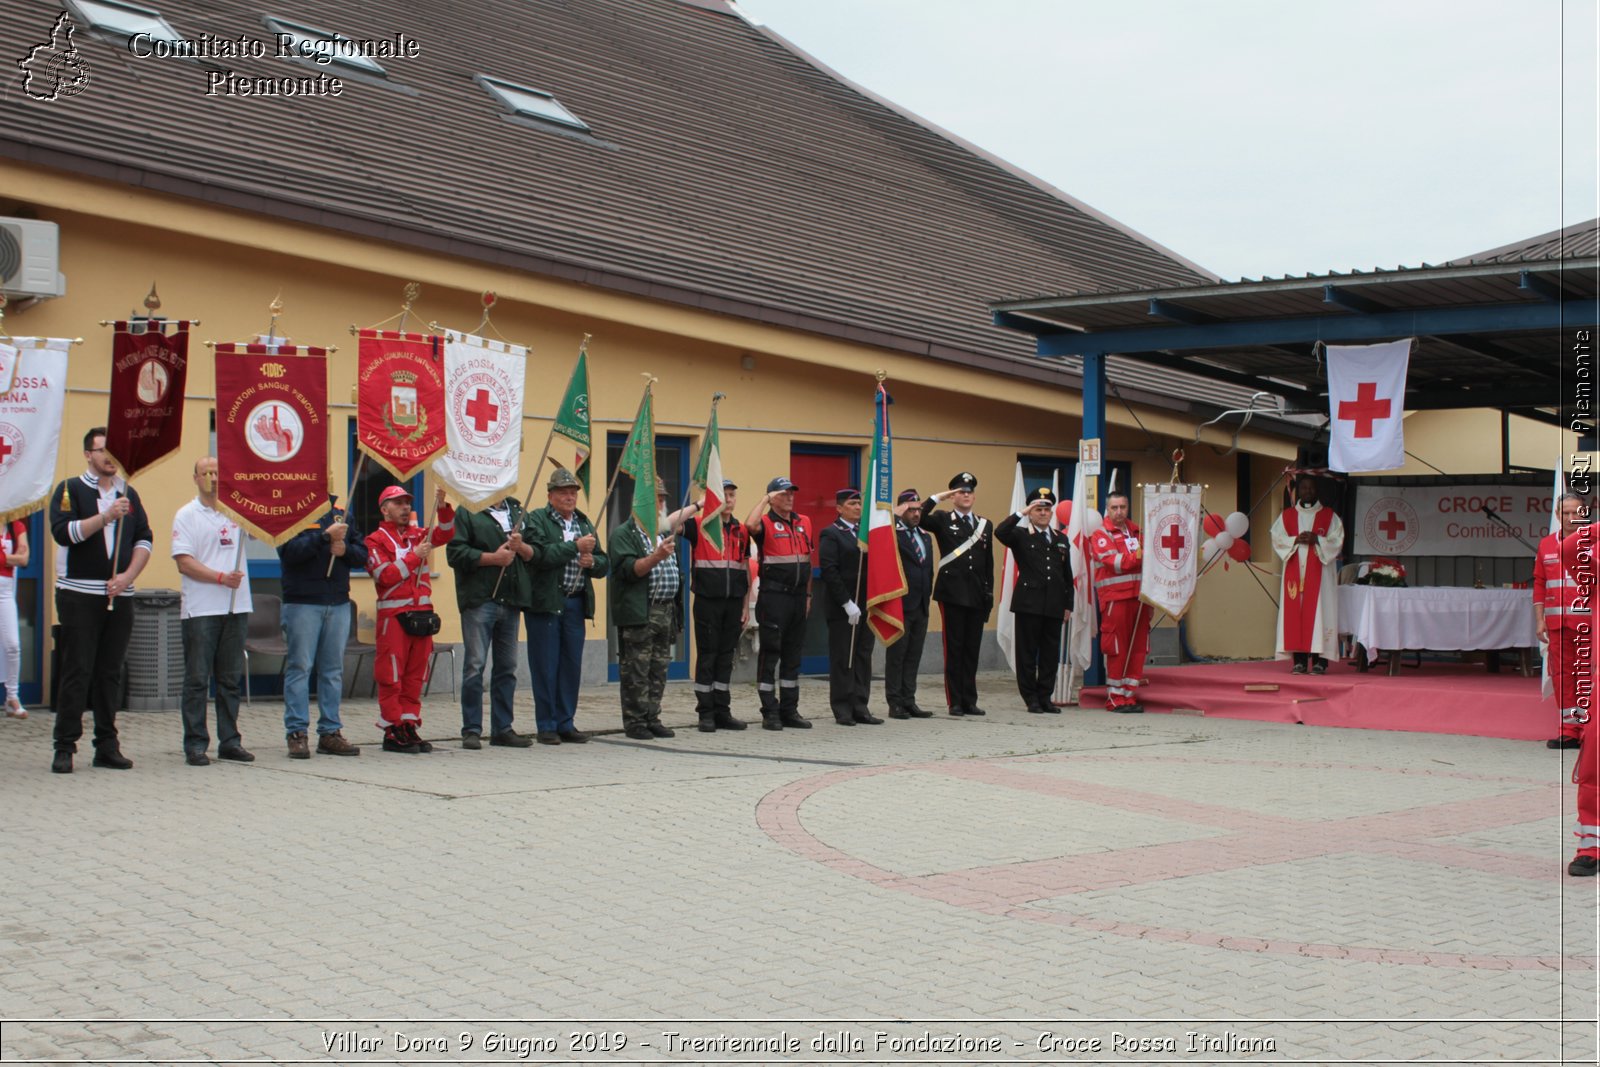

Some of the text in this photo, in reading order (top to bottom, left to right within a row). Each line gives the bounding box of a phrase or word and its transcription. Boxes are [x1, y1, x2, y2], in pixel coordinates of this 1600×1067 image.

[14, 377, 49, 389] OSSA
[448, 359, 519, 407] CROCE ROSSA ITALIANA
[227, 381, 319, 424] DONATORI SANGUE PIEMONTE
[366, 431, 441, 458] VILLAR DORA
[446, 450, 512, 467] ELEGAZIONE DI
[234, 472, 318, 481] GRUPPO COMUNALE
[455, 470, 498, 484] GIAVENO
[272, 489, 282, 498] DI
[230, 490, 318, 515] BUTTIGLIERA ALTA
[1438, 496, 1513, 513] CROCE
[1447, 522, 1522, 538] Comitato
